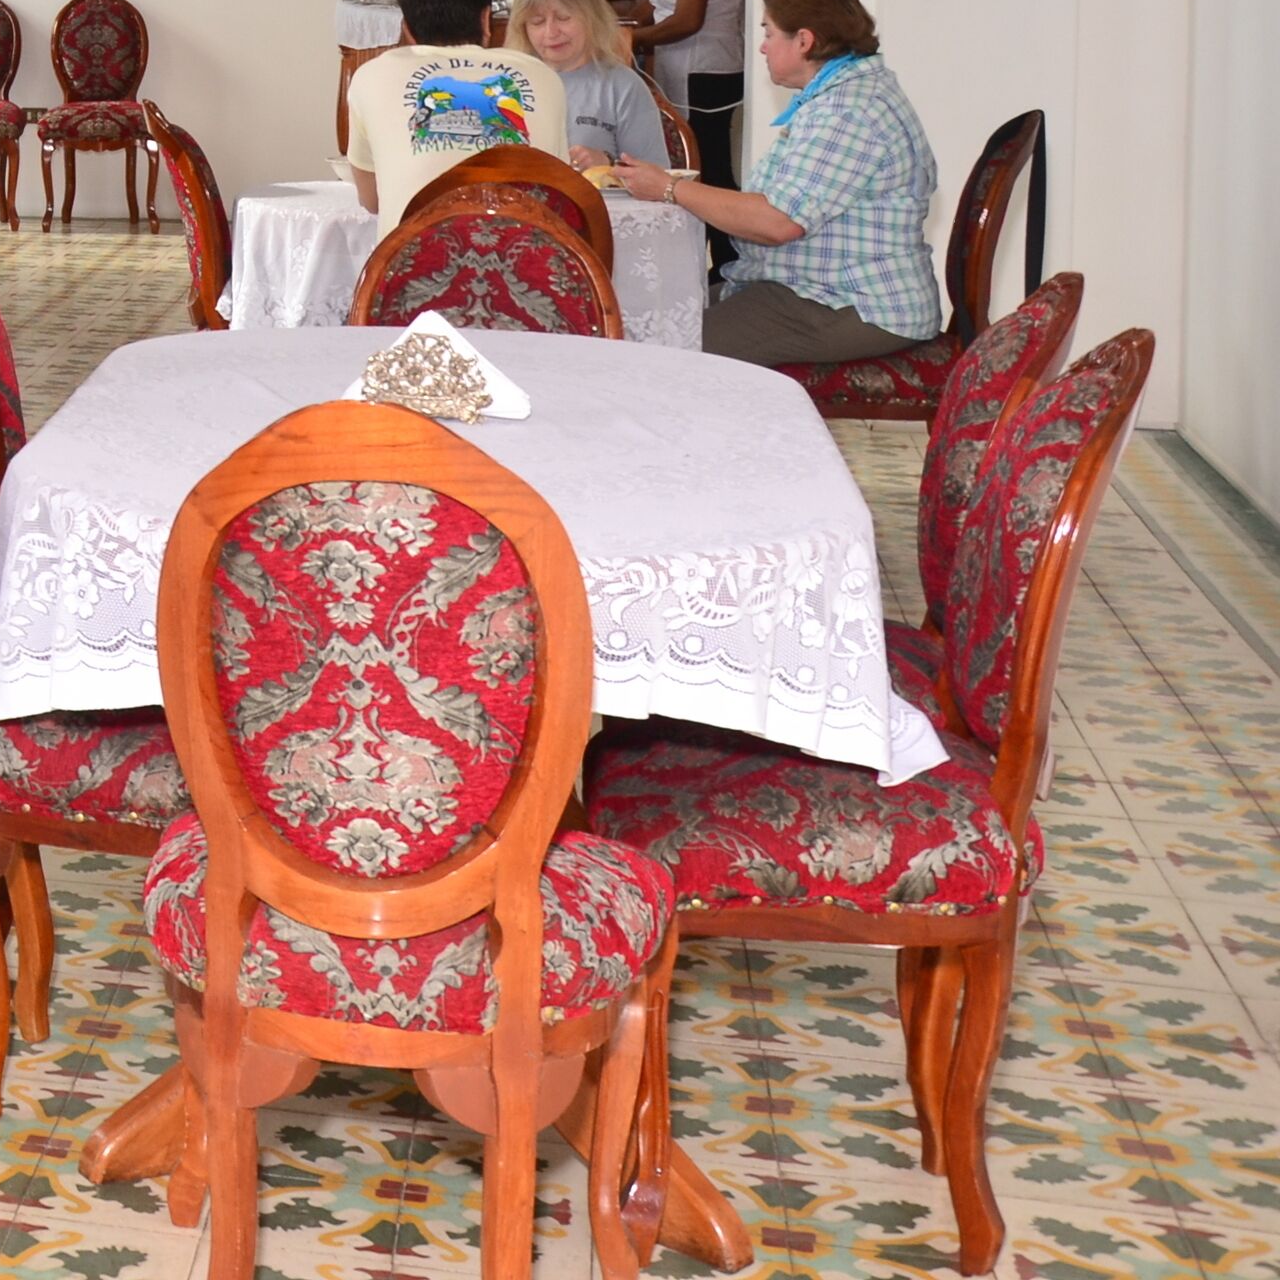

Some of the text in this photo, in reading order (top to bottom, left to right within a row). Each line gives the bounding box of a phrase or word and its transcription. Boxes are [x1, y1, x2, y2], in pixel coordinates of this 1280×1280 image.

[403, 58, 535, 113] JARDIN DE AMERICA
